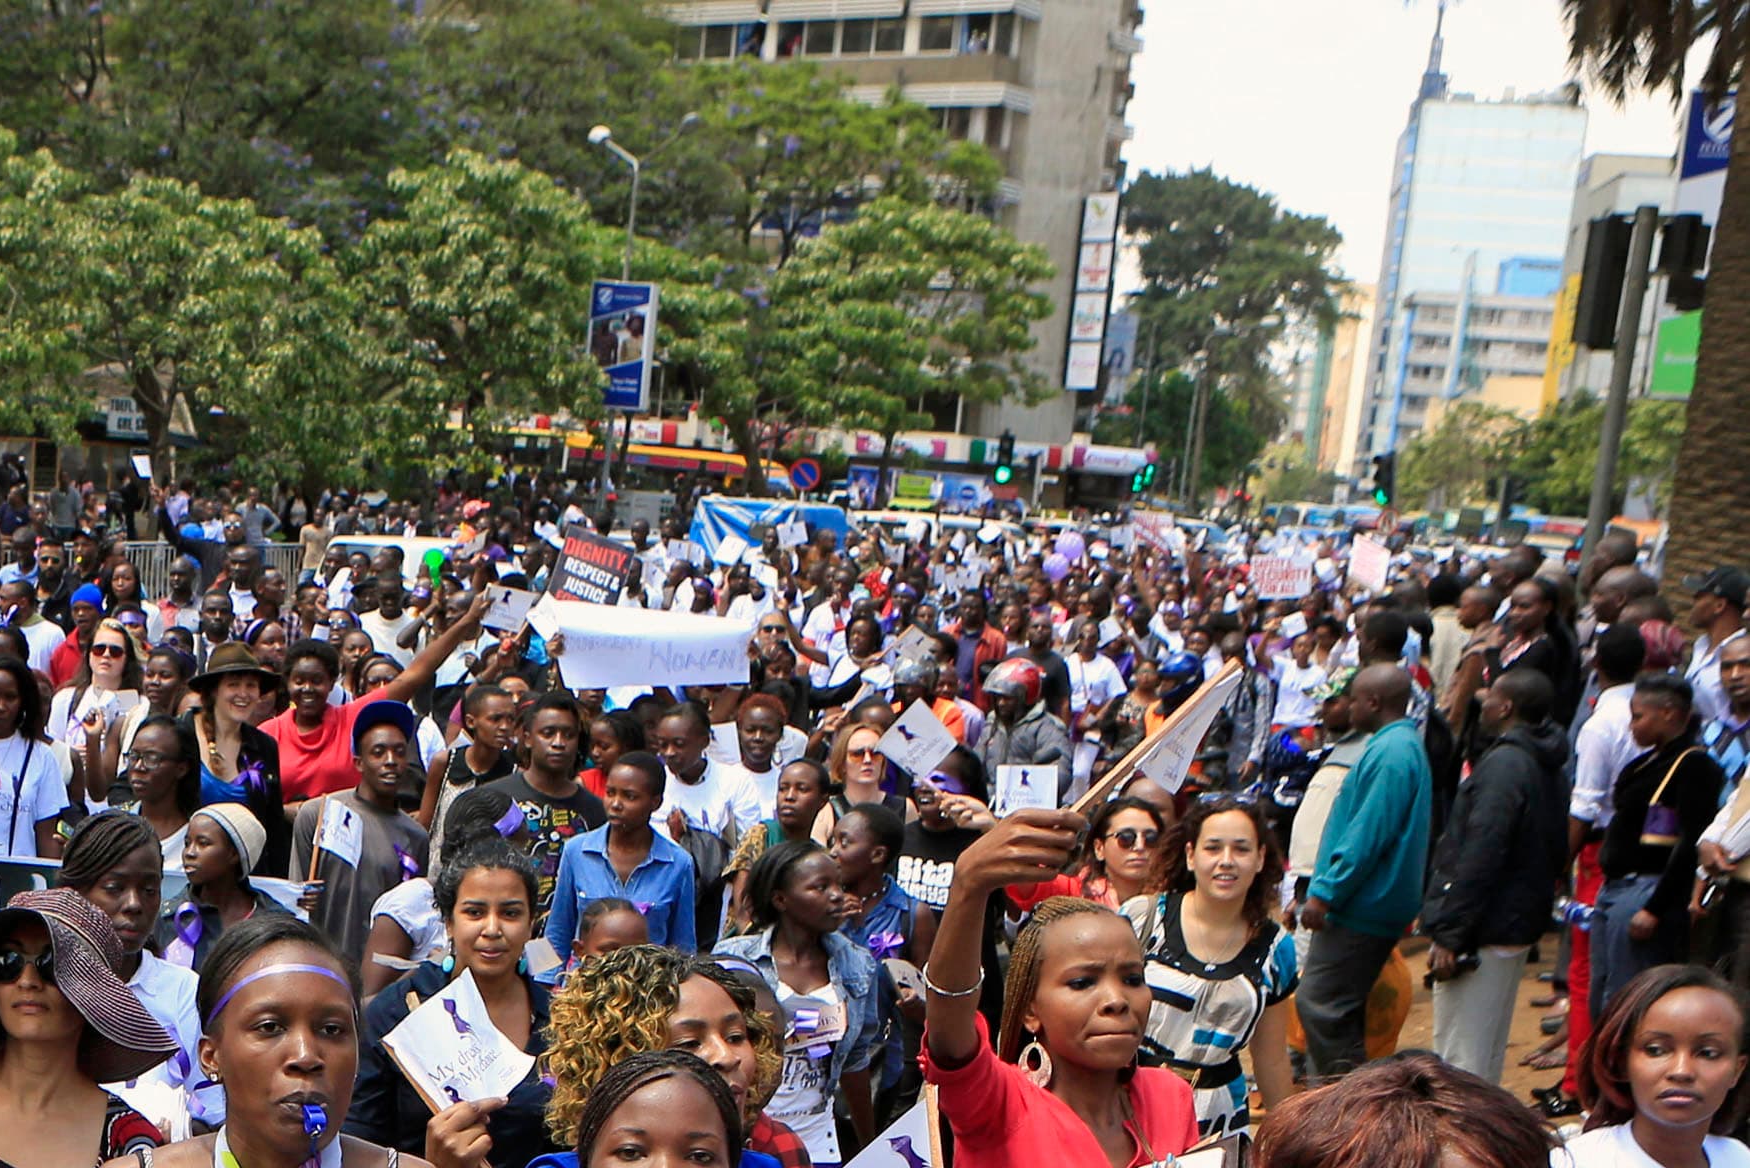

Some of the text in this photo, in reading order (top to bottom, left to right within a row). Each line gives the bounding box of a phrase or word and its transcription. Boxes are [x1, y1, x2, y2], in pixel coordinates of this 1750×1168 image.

[563, 556, 613, 587] RESPECT
[562, 575, 609, 604] JUSTICE
[427, 1061, 456, 1082] My
